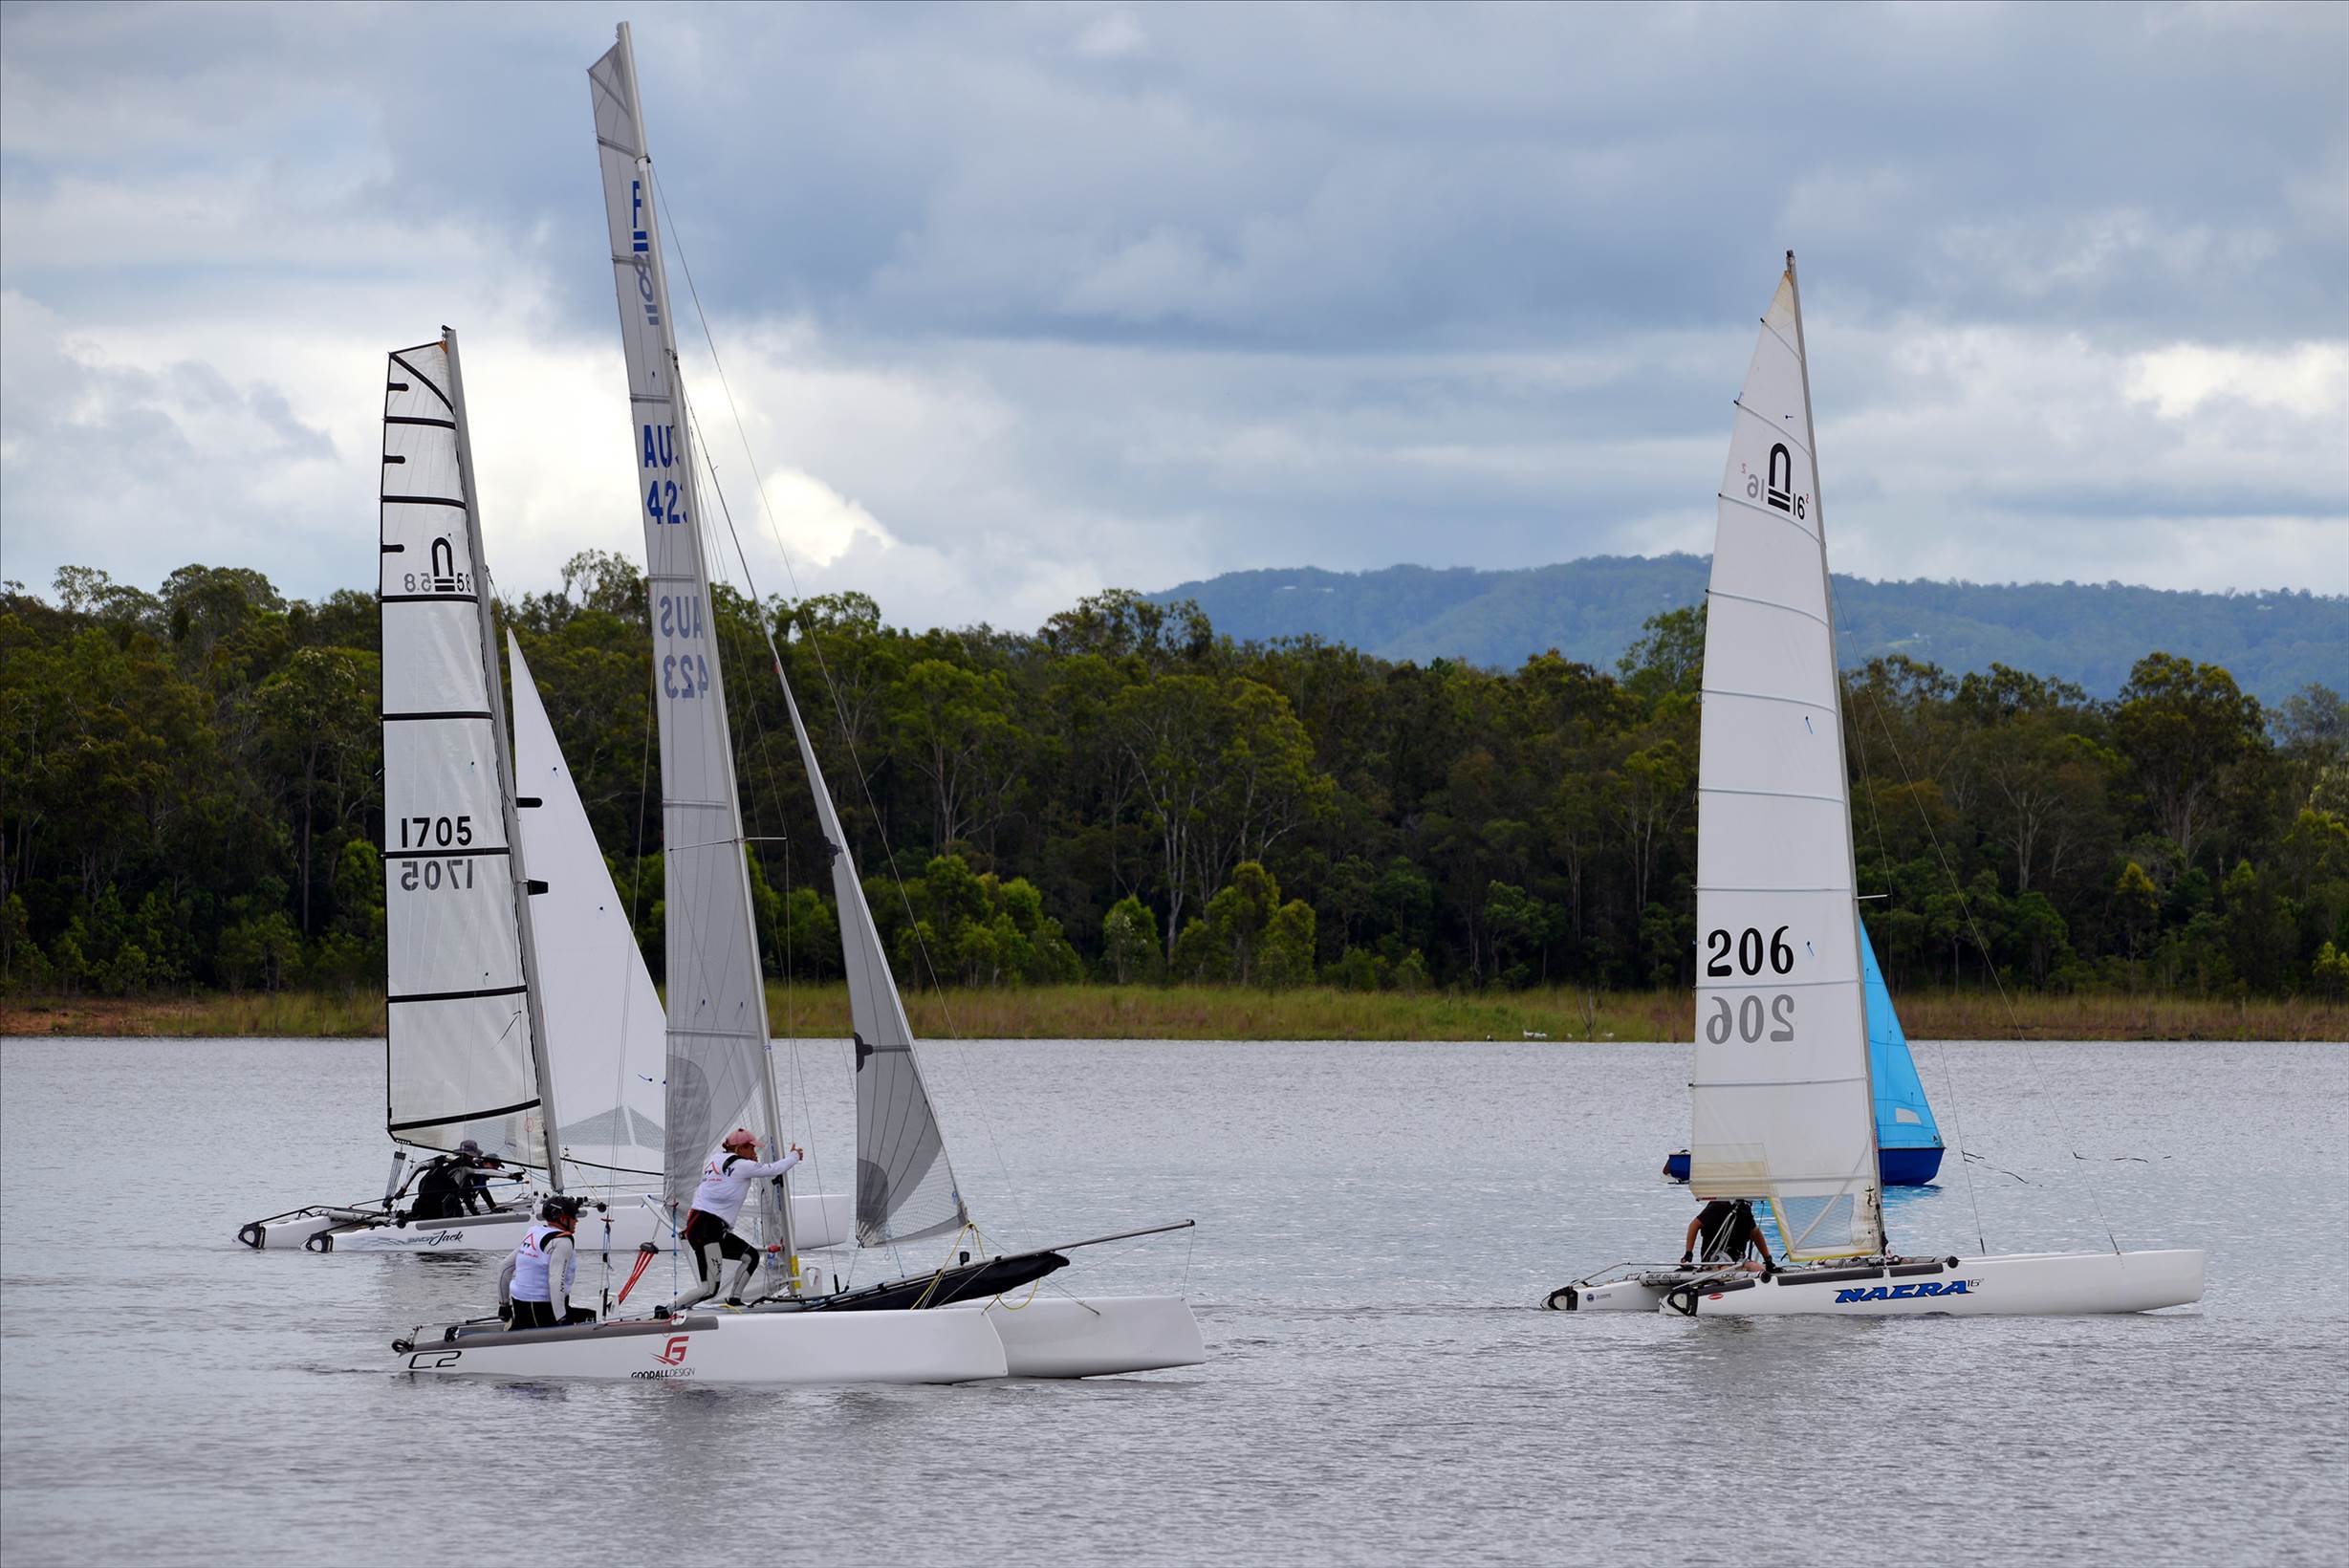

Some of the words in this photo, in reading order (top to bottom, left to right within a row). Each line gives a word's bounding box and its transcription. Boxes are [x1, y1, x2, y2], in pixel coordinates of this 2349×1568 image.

[643, 425, 680, 468] AU
[647, 480, 687, 525] 42
[401, 816, 472, 848] 1705
[1707, 926, 1794, 977] 206
[428, 1230, 464, 1246] Jack
[408, 1350, 462, 1369] C2
